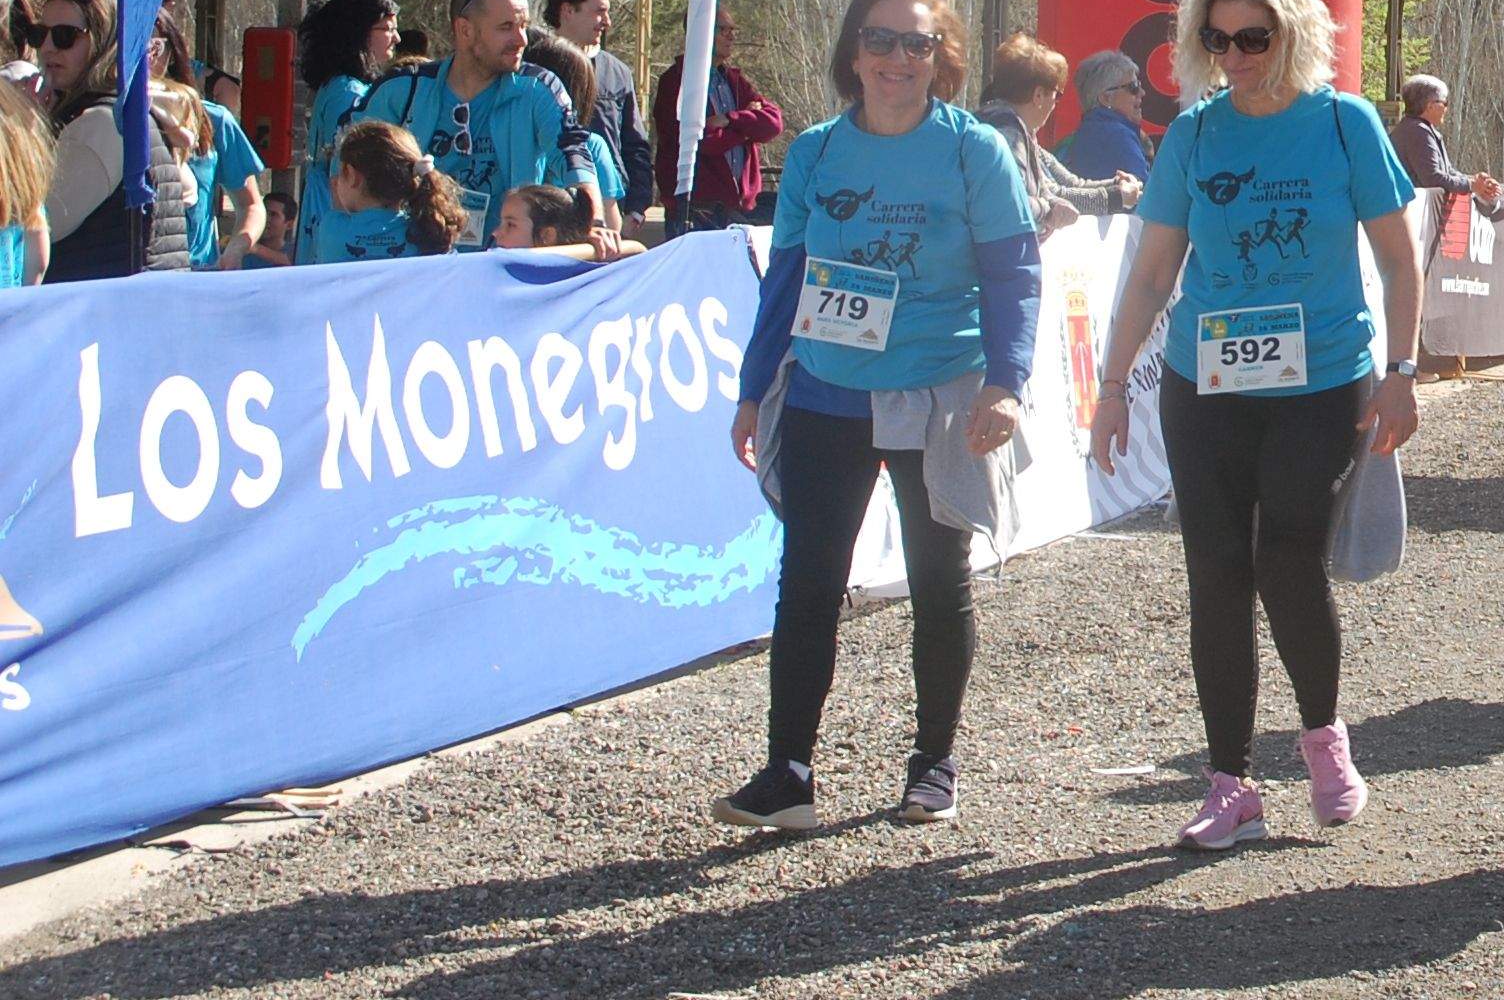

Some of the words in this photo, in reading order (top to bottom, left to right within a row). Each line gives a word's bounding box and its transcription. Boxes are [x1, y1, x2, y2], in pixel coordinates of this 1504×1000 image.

[1252, 177, 1309, 190] Carrera
[1248, 189, 1313, 204] solidaria
[870, 200, 925, 213] Carrera
[866, 212, 927, 225] solidaria
[817, 289, 869, 321] 719
[1220, 336, 1282, 366] 592
[73, 342, 284, 538] Los
[319, 295, 743, 491] Monegros
